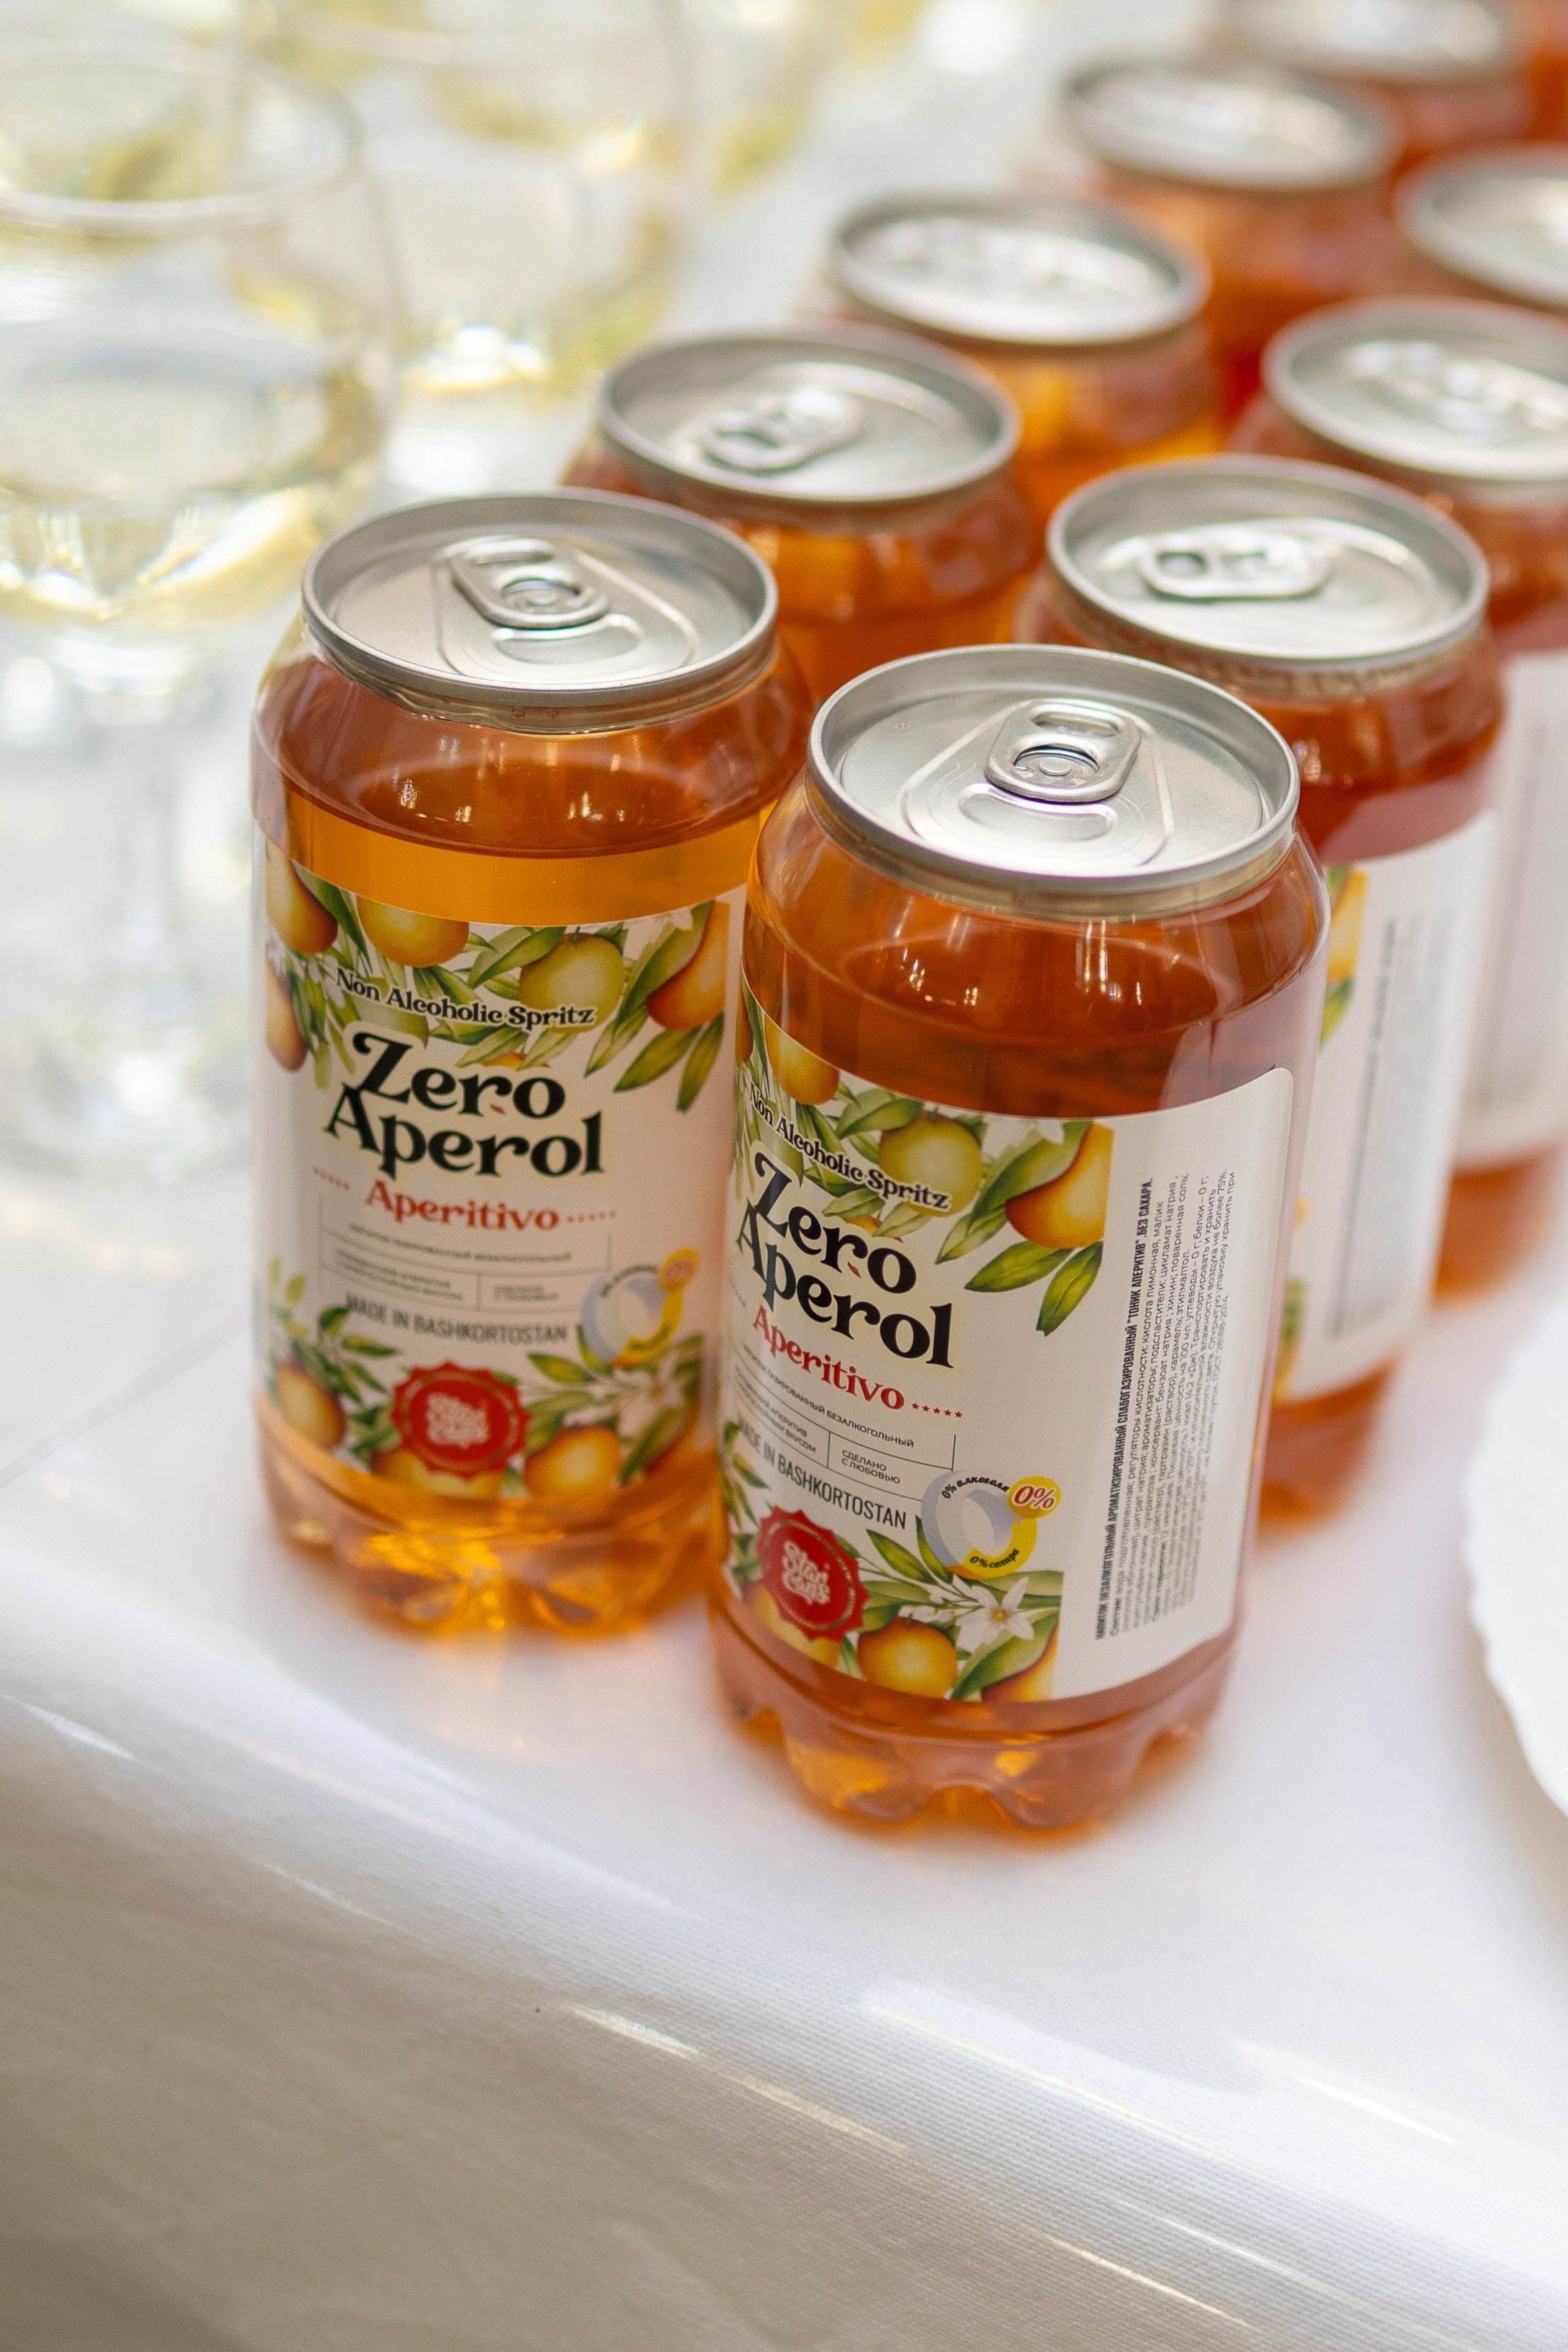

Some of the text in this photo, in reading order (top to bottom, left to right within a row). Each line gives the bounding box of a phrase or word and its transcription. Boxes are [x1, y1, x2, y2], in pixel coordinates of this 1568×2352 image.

[336, 968, 595, 1030] Non Alcoholic Spritz
[352, 1031, 566, 1119] Zero
[323, 1082, 604, 1181] Aperol
[749, 1084, 951, 1210] Non Alcoholic Spritz
[364, 1179, 559, 1231] Aperitivo
[1138, 1178, 1153, 1216] САХАРА.
[1165, 1182, 1177, 1222] натрия
[1217, 1168, 1228, 1194] 75%.
[754, 1152, 917, 1294] Zero
[1154, 1201, 1164, 1236] малик
[1171, 1205, 1185, 1272] поваренная
[1194, 1205, 1205, 1239] белки
[1212, 1232, 1219, 1245] не
[1213, 1195, 1224, 1230] более
[1131, 1240, 1146, 1287] АПЕРИТИВ"
[1147, 1239, 1161, 1297] лимонная,
[1160, 1225, 1172, 1277] цикламат
[1191, 1246, 1210, 1347] Транспортировать
[1205, 1189, 1216, 1234] хранить
[1208, 1248, 1218, 1290] воздуха
[1208, 1294, 1221, 1350] Открытую
[1216, 1244, 1228, 1293] упаковку
[1222, 1196, 1233, 1241] хранить
[735, 1197, 953, 1369] Aperol
[1127, 1289, 1141, 1323] "ТОНИК
[1167, 1275, 1178, 1311] хинин;
[1176, 1249, 1189, 1314] этилмалтол.
[1185, 1269, 1198, 1321] углеводы
[393, 1308, 409, 1331] IN
[414, 1314, 567, 1345] BASHKORTOSTAN
[1142, 1300, 1153, 1343] кислота
[1150, 1279, 1167, 1363] подсластители:
[1163, 1319, 1172, 1357] натрия
[1170, 1316, 1182, 1371] карамель;
[1201, 1293, 1212, 1351] влажности
[752, 1304, 905, 1410] Aperitivo
[1117, 1325, 1137, 1423] СЛАБОГАЗИРОВАННЫЙ
[1180, 1343, 1189, 1360] 100
[1180, 1362, 1187, 1375] на
[1134, 1345, 1148, 1416] кислотности:
[1155, 1360, 1168, 1402] бензоат
[1163, 1373, 1178, 1426] (раствор),
[1173, 1378, 1186, 1426] ценность
[1192, 1354, 1206, 1433] относительной
[767, 1370, 825, 1415] ГАЗИРОВАННЫЙ
[827, 1409, 914, 1448] БЕЗАЛКОГОЛЬНЫЙ
[1141, 1365, 1159, 1450] ароматизаторы;
[785, 1428, 816, 1453] ВКУСОМ
[842, 1450, 887, 1472] СДЕЛАНО
[1128, 1418, 1141, 1479] регуляторы
[1158, 1429, 1170, 1482] тартразин
[1167, 1430, 1180, 1479] Пищевая
[779, 1454, 907, 1530] BASHKORTOSTAN
[841, 1458, 900, 1484] С ЛЮБОВЬЮ
[941, 1484, 957, 1499] 0%
[1014, 1485, 1054, 1508] 0%
[1107, 1425, 1127, 1521] АРОМАТИЗИРОВАННЫЙ
[1138, 1452, 1149, 1492] натрия;
[1134, 1493, 1143, 1530] цитрат
[1144, 1476, 1155, 1528] сукралоза
[970, 1556, 988, 1568] 0%
[1099, 1523, 1116, 1601] БЕЗАЛКОГОЛЬНЫЙ
